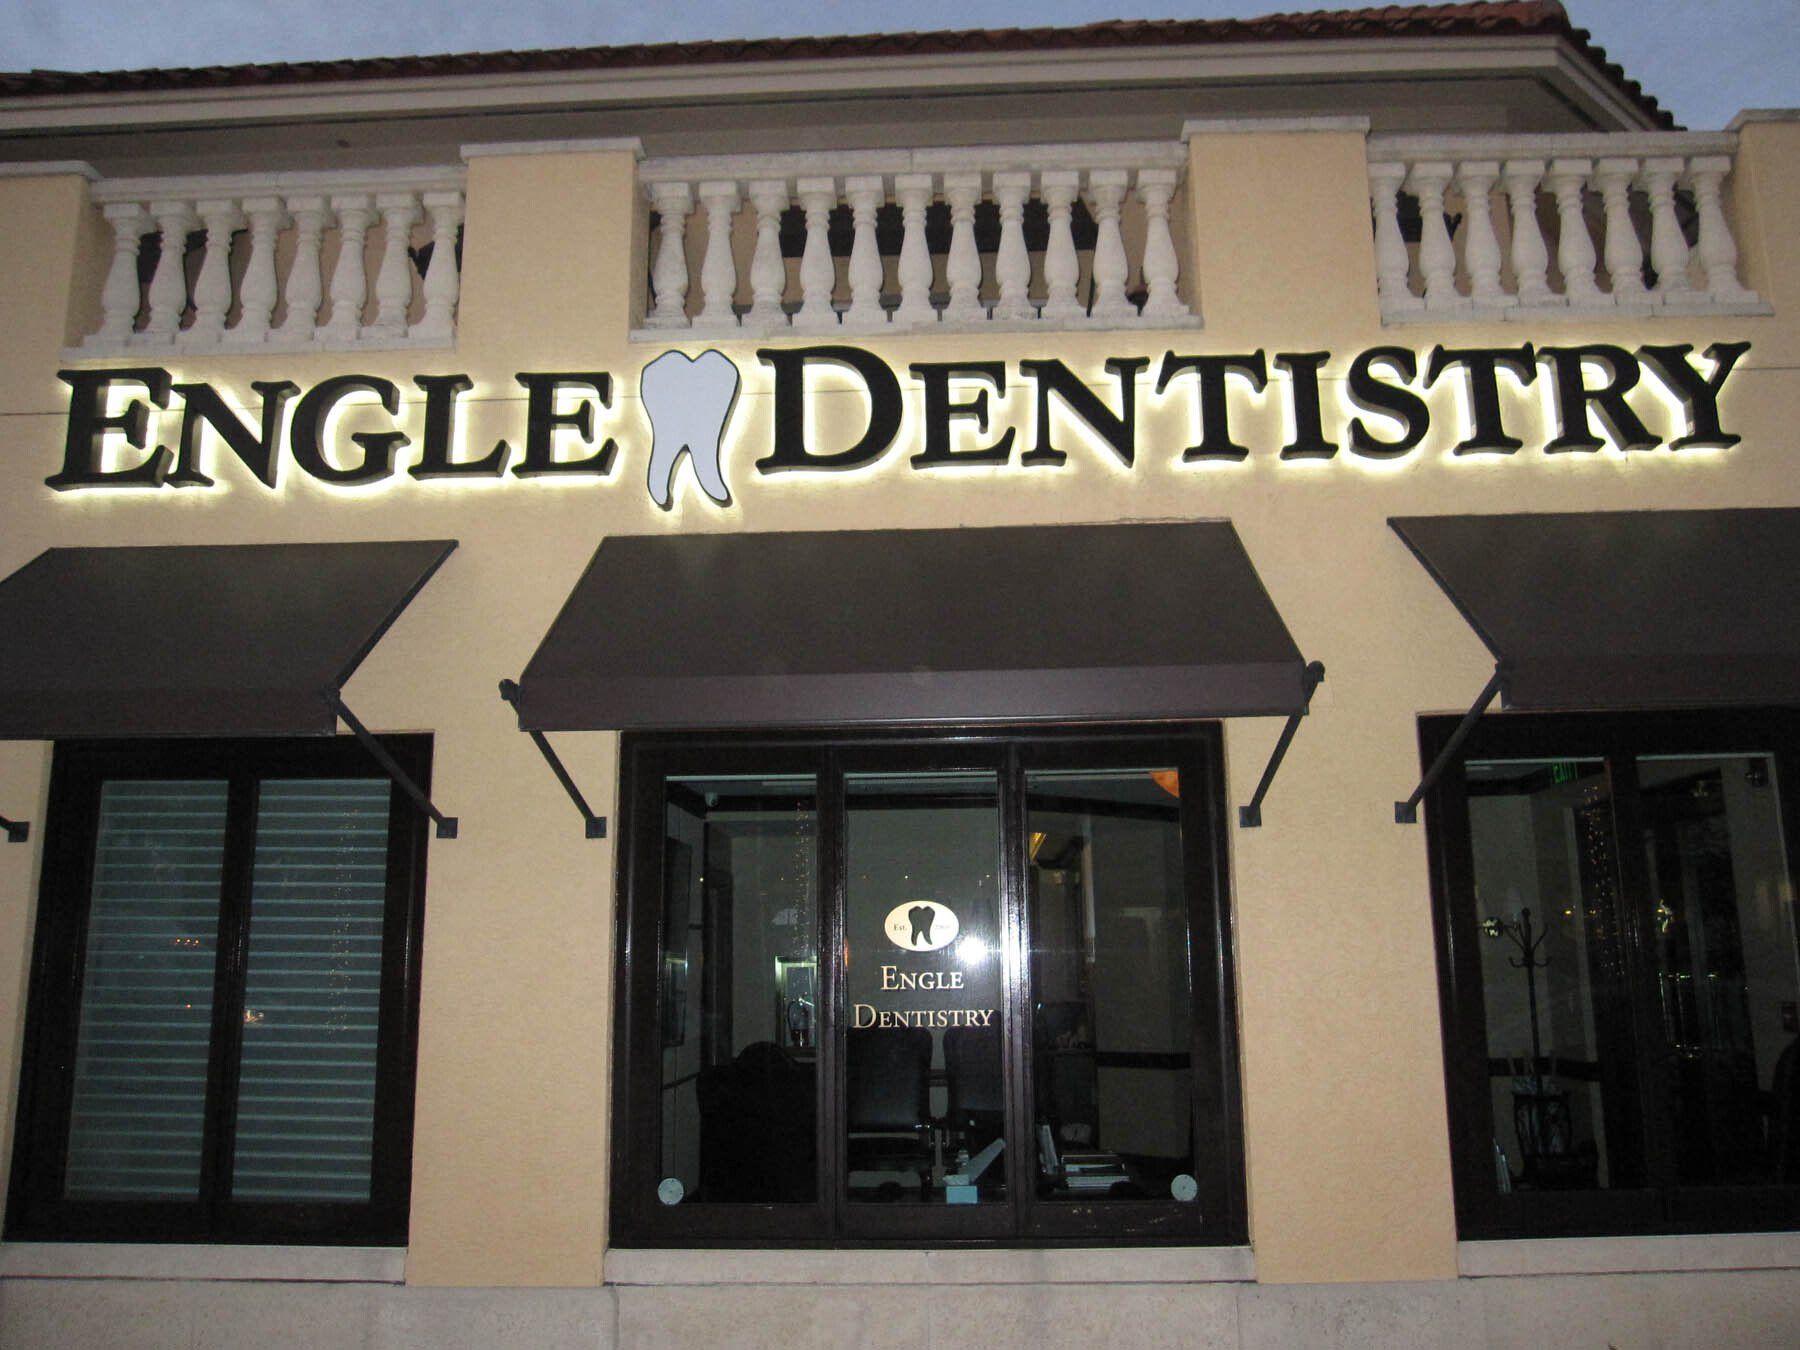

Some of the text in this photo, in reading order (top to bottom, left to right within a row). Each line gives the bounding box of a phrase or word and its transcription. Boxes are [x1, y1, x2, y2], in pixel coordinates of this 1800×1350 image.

[44, 341, 1752, 491] ENGLE DENTISTRY
[880, 965, 964, 990] ENGLE
[853, 1003, 994, 1029] DENTISTRY
